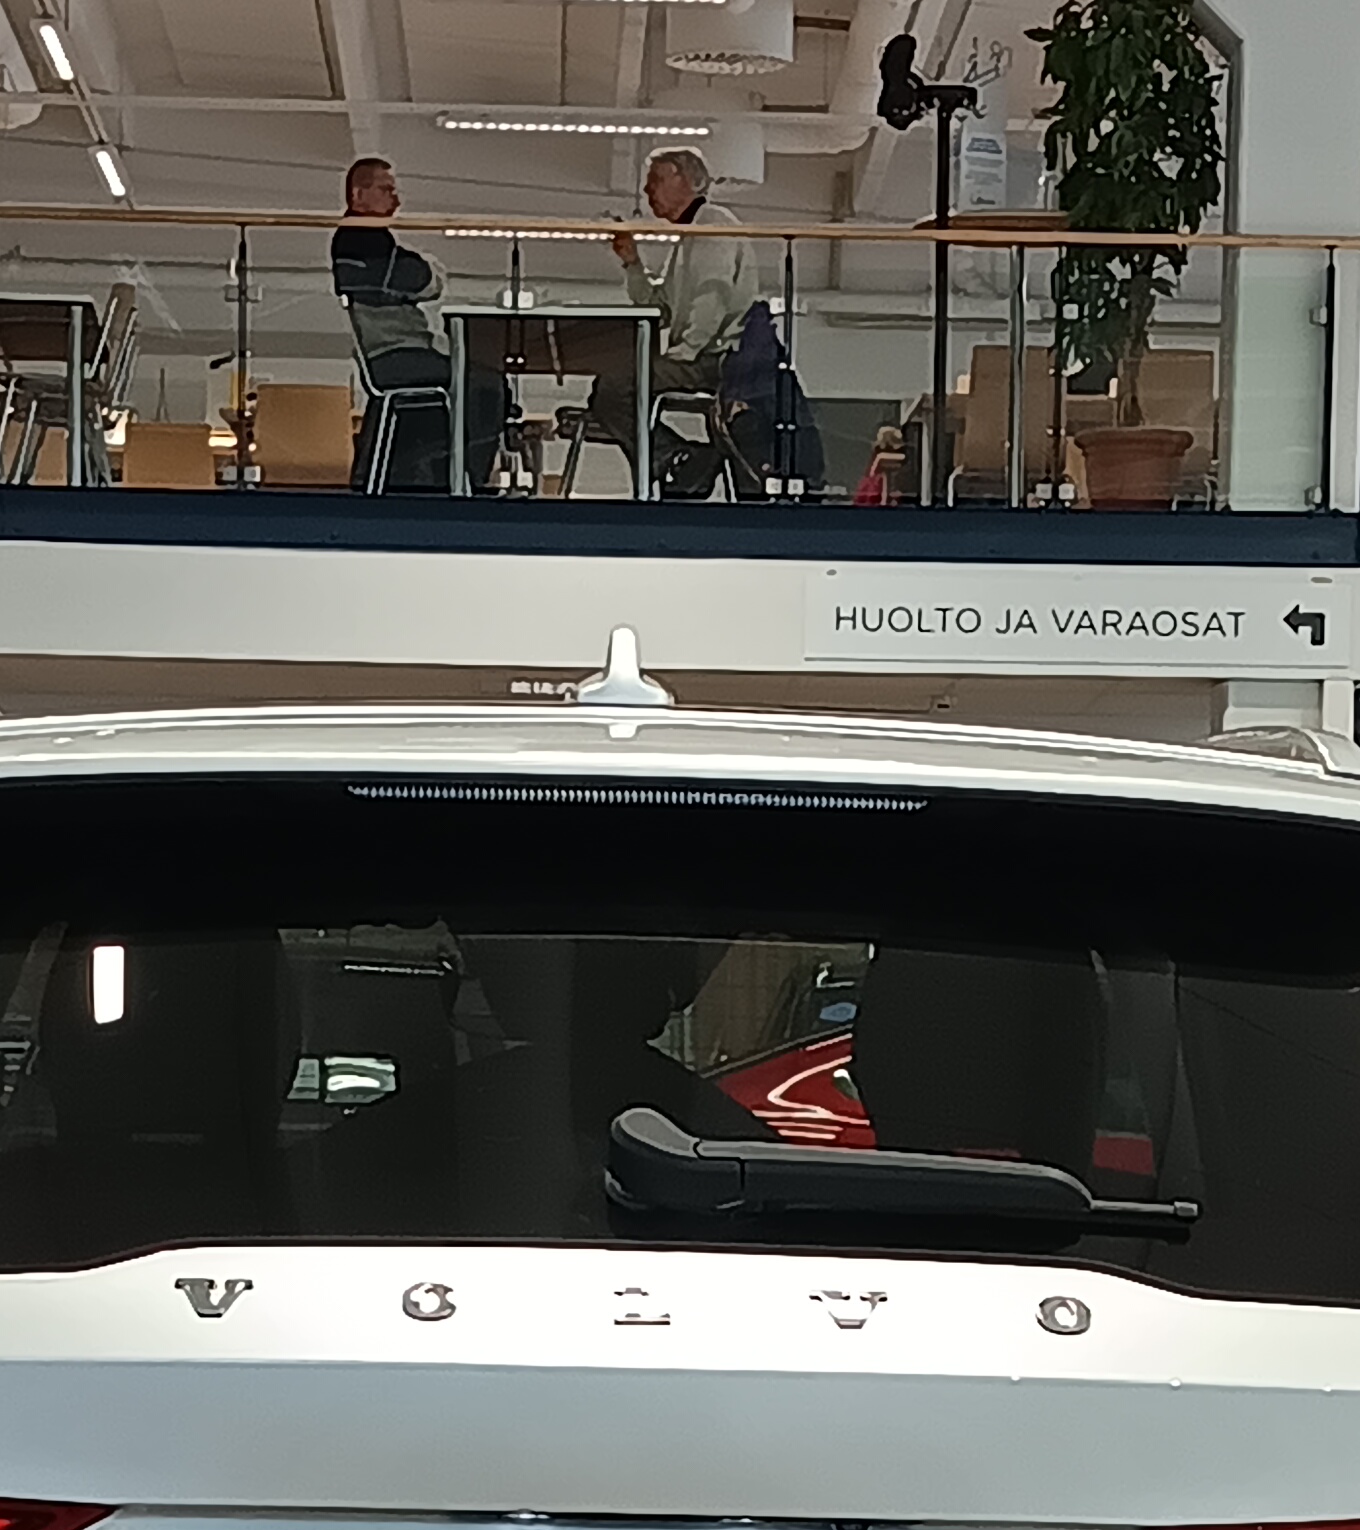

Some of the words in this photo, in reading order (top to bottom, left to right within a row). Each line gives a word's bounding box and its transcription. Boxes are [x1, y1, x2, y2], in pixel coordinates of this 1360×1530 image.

[834, 606, 982, 634] HUOLTO
[994, 608, 1038, 635] JA
[1050, 608, 1247, 638] VARAOSAT
[173, 1276, 1093, 1336] VOLVO
